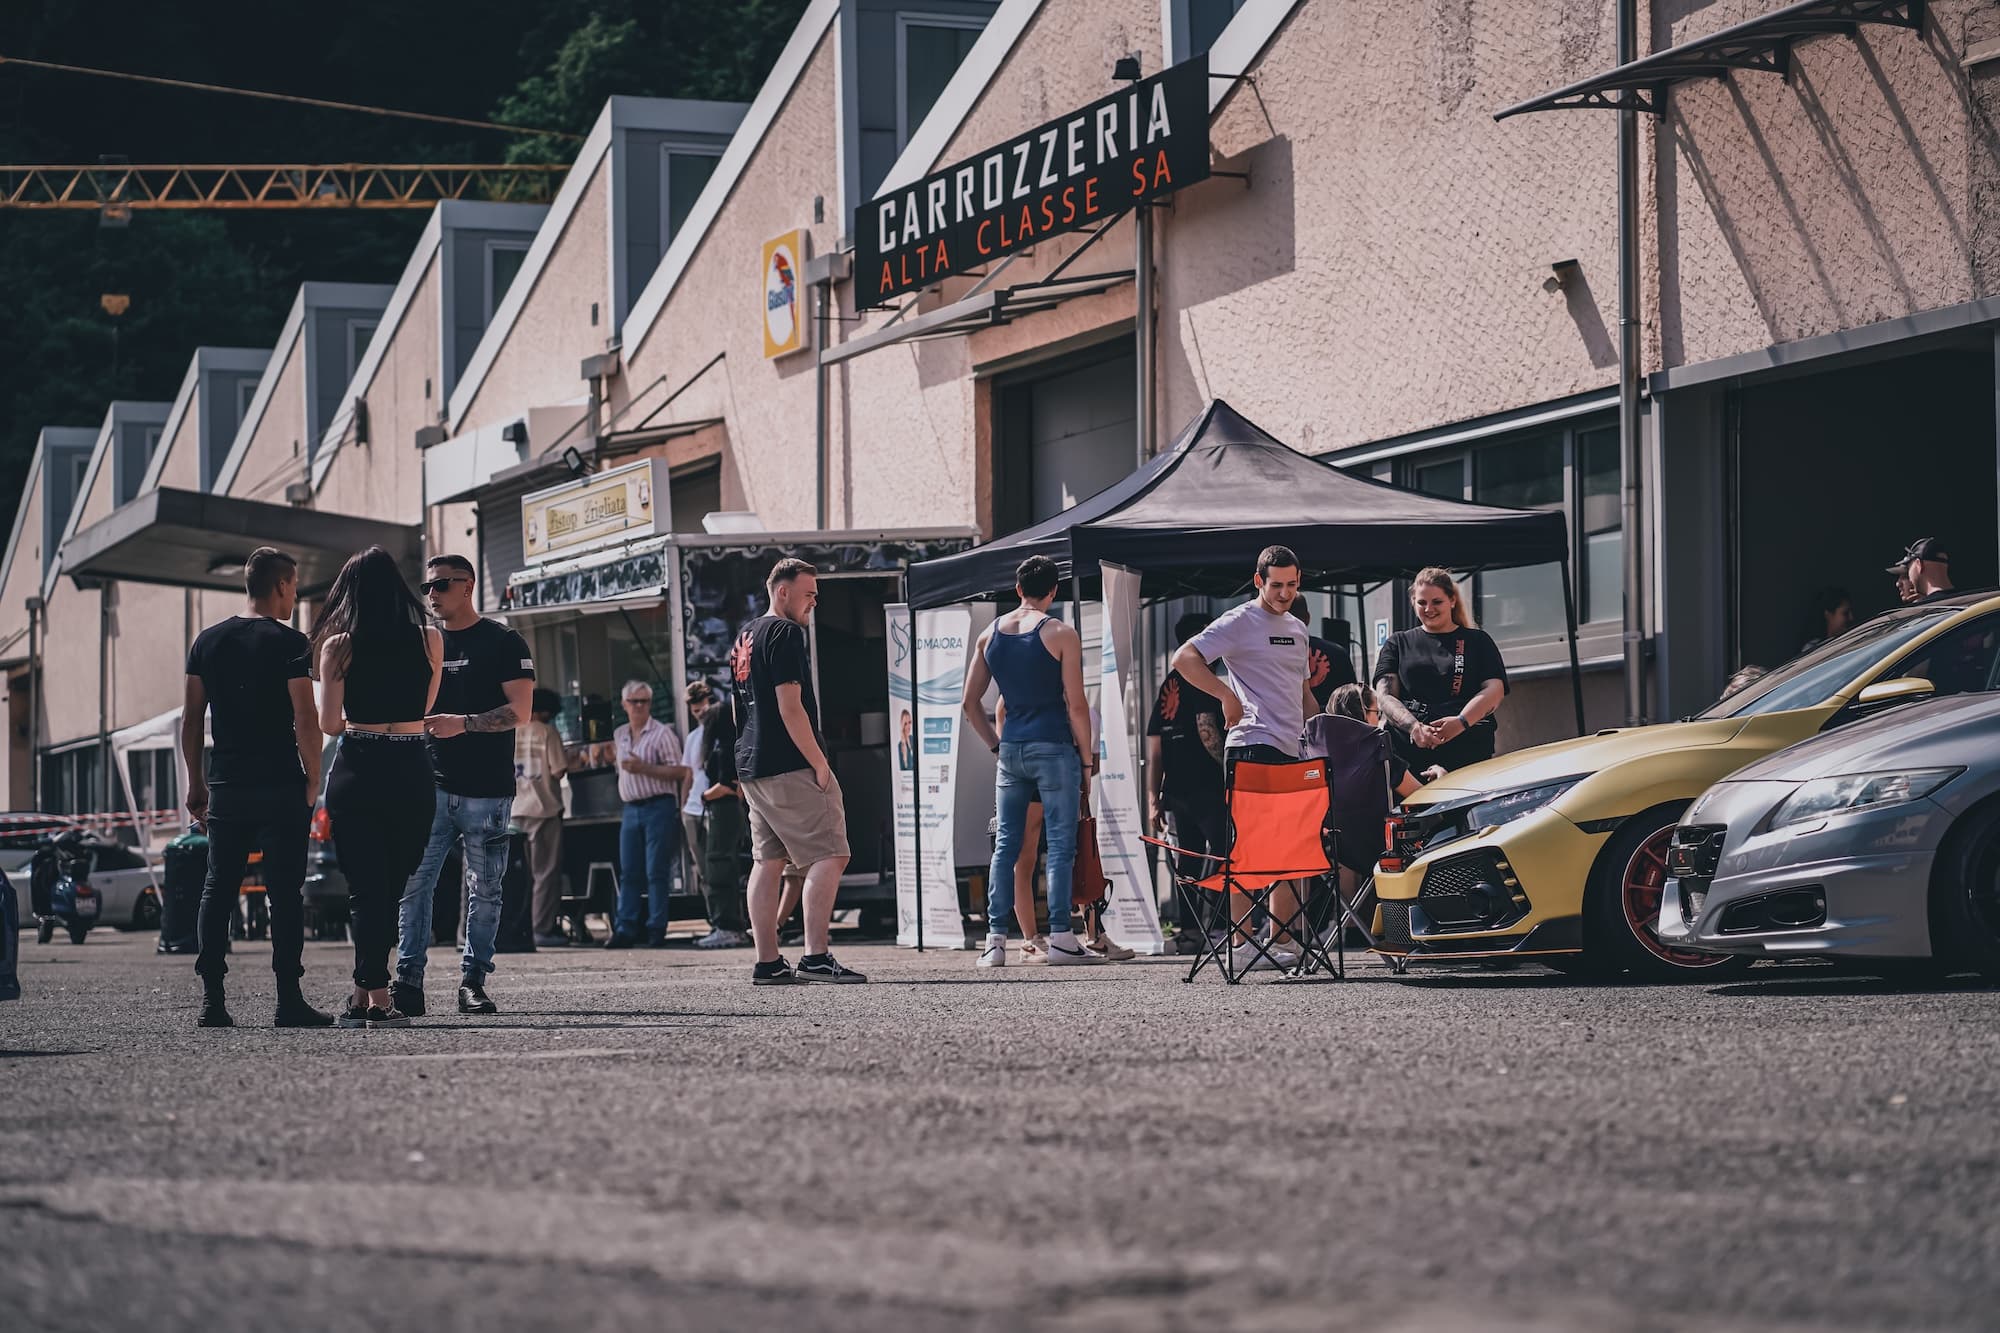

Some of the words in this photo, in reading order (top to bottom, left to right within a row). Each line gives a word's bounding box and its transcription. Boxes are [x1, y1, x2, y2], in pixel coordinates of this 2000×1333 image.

[879, 82, 1171, 253] CARROZZERIA
[880, 240, 949, 294] ALTA
[977, 177, 1098, 255] CLASSE
[1132, 150, 1171, 196] SA
